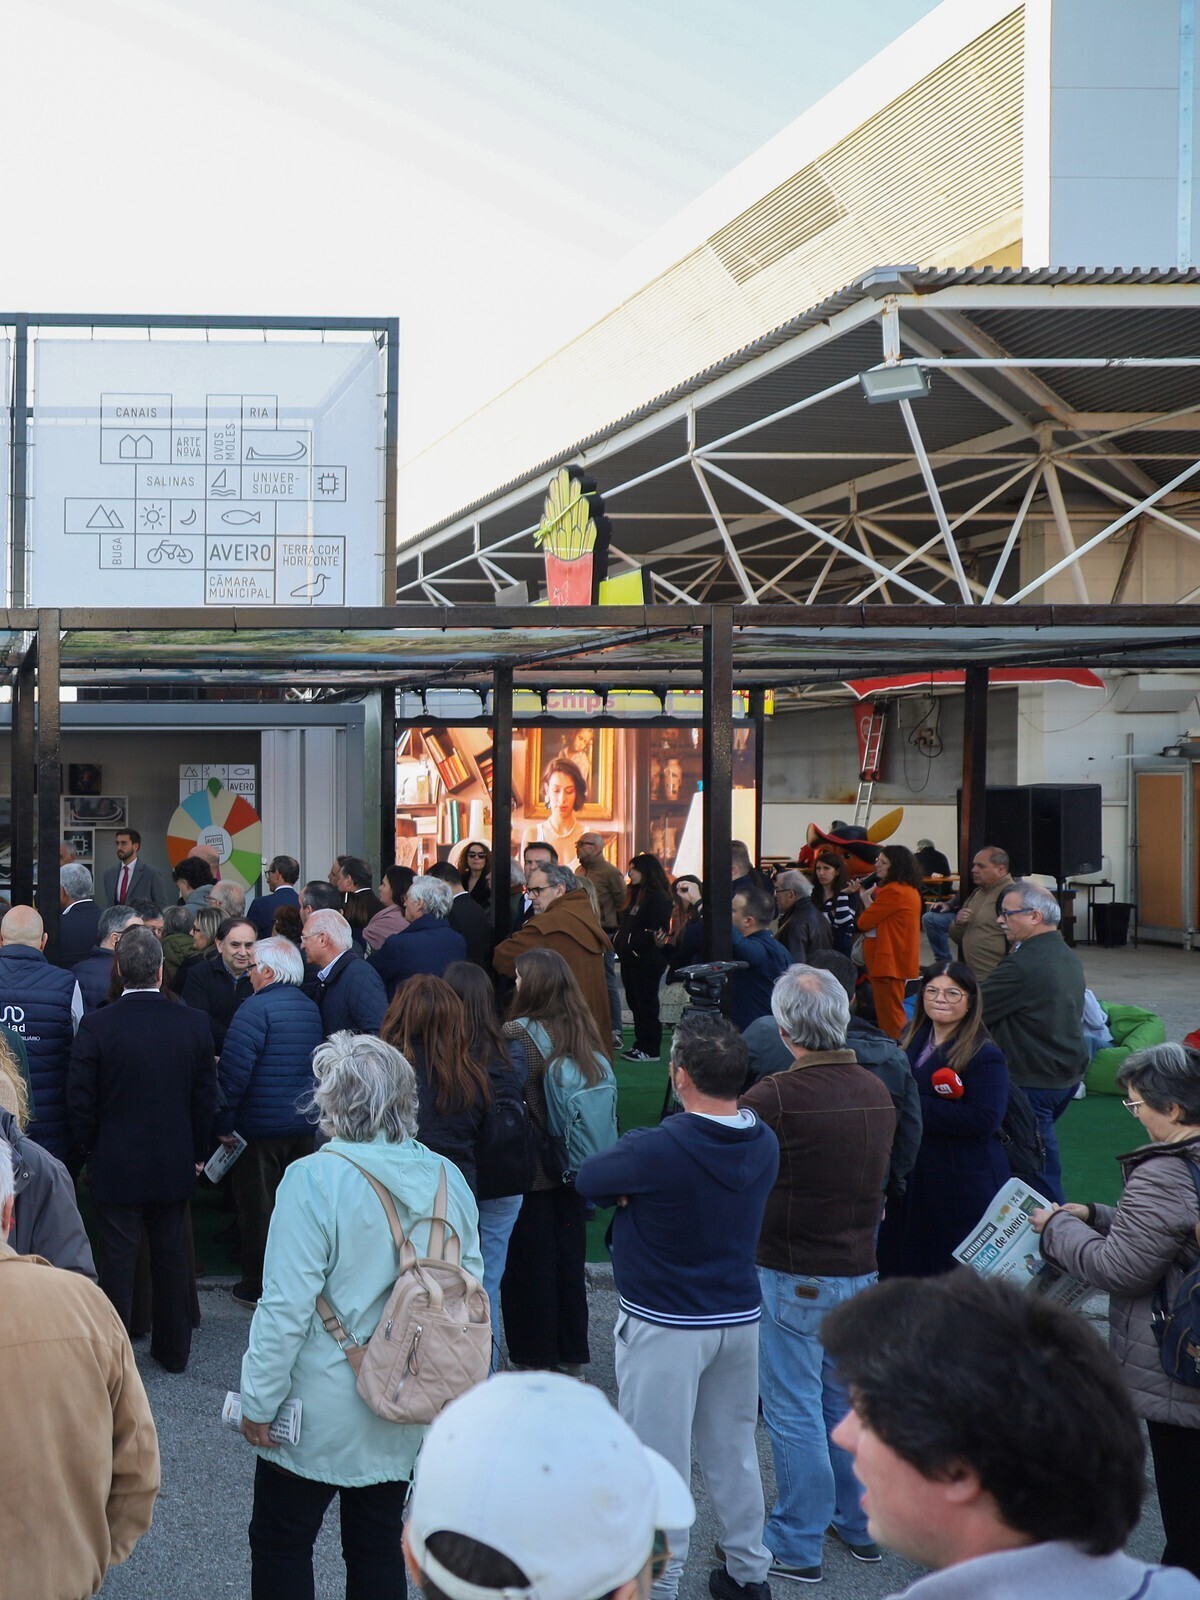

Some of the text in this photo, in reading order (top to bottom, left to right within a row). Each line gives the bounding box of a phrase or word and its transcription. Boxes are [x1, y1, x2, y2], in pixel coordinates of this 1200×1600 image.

[116, 407, 157, 418] CANAIS
[250, 407, 269, 418] RIA
[176, 436, 201, 447] ARTE
[213, 432, 224, 460] OVOS
[225, 423, 236, 460] MOLES
[146, 475, 195, 487] SALINAS
[253, 472, 300, 483] UNIVER-
[252, 484, 294, 494] SIDADE
[112, 537, 122, 565] BUGA
[209, 543, 271, 561] AVEIRO
[282, 544, 315, 555] TERRA
[318, 544, 340, 555] COM
[282, 556, 339, 566] HORIZONTE
[209, 588, 271, 599] MUNICIPAL
[229, 783, 254, 791] AVEIRO
[973, 1246, 998, 1272] Diário
[994, 1236, 1006, 1249] de
[1006, 1212, 1027, 1239] Aveiro
